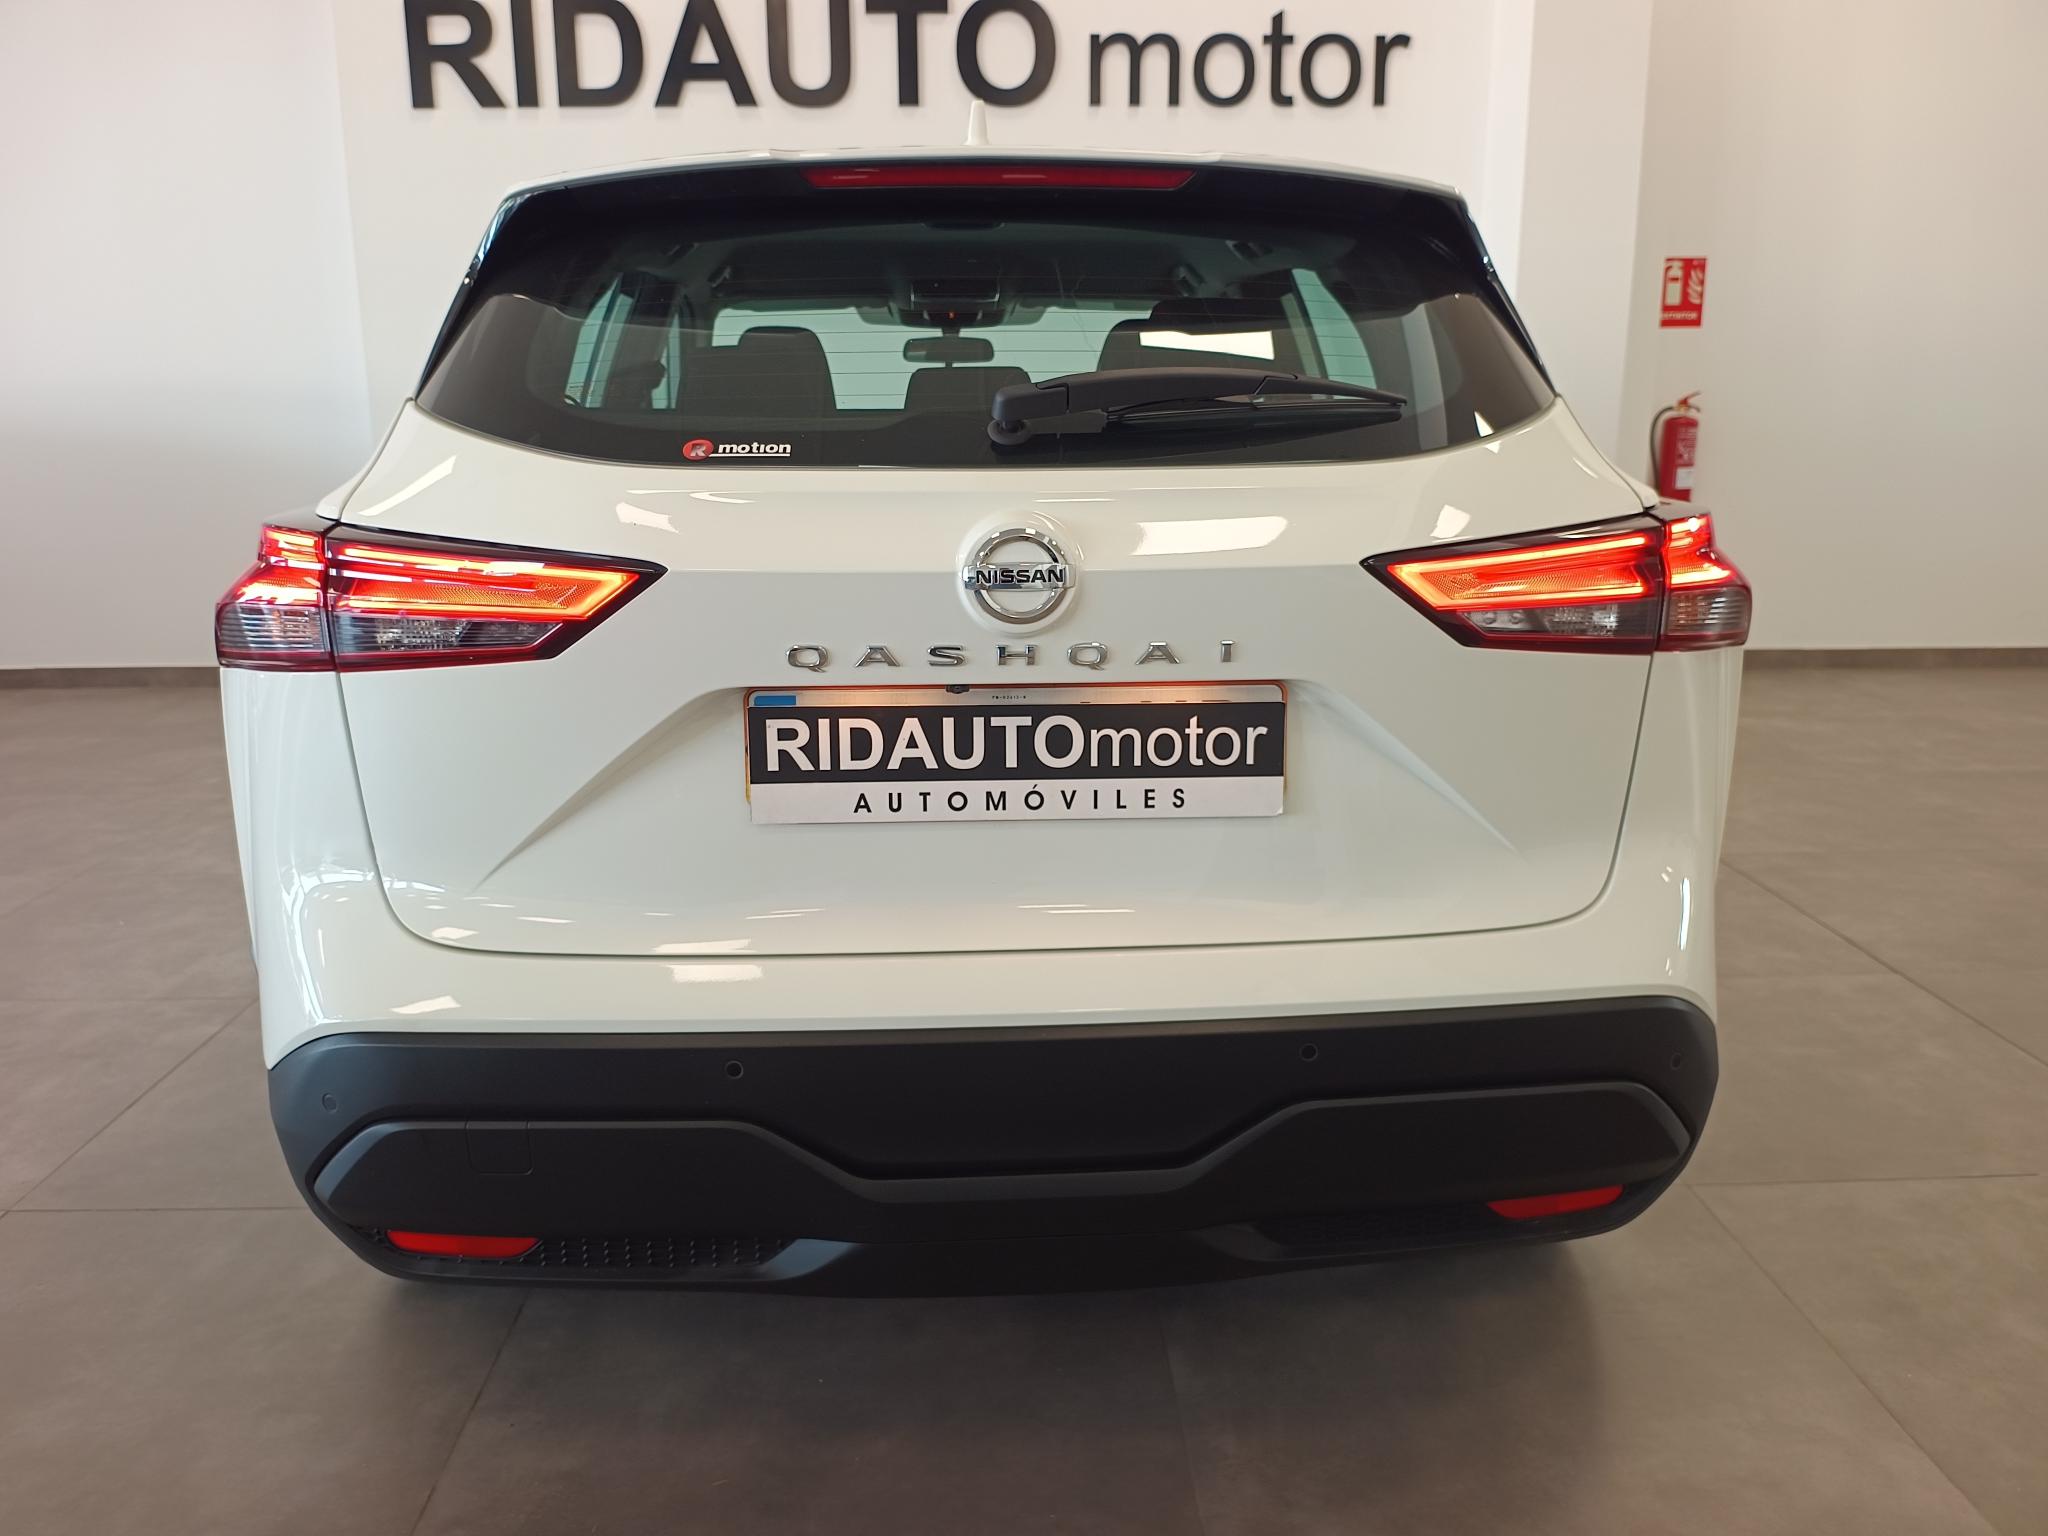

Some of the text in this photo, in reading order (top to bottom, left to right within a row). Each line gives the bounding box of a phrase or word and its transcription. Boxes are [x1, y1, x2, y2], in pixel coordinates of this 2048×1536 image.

[403, 0, 1411, 109] RIDAUTO motor
[718, 442, 792, 454] motion
[975, 568, 1064, 584] NISSAN
[785, 639, 1237, 673] QASHQAI
[765, 714, 1268, 772] RIDAUTOmotor
[853, 784, 1186, 813] AUTOMÓVILES
